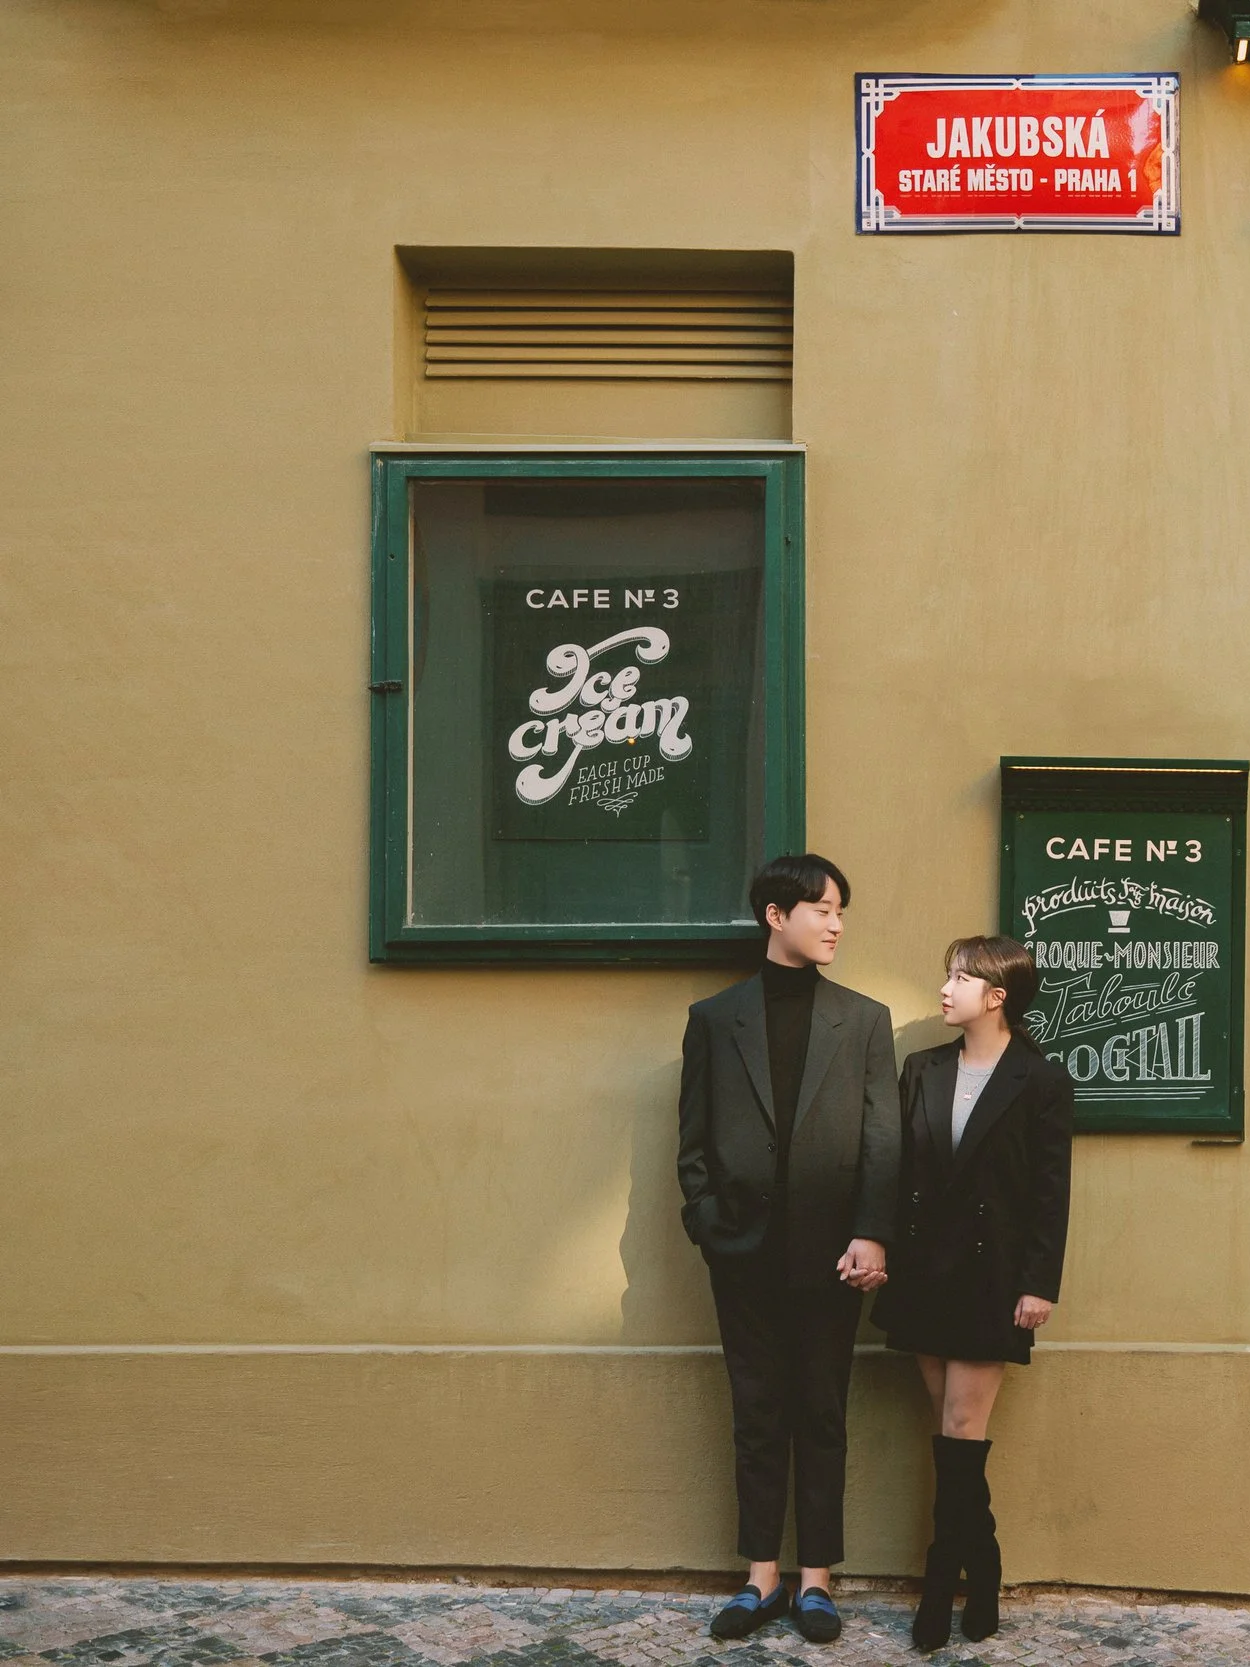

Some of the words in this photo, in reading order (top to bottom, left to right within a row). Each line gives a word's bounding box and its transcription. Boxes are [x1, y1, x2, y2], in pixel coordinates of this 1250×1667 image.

[926, 109, 1110, 159] JAKUBSKÁ
[899, 164, 961, 192] STARÉ
[967, 164, 1034, 192] MĚSTO
[1054, 168, 1122, 192] PRAHA
[1128, 168, 1137, 192] 1
[526, 589, 610, 609] CAFE
[663, 588, 679, 609] 3
[529, 626, 670, 716] Ice
[508, 696, 693, 805] cream
[577, 761, 618, 784] EACH
[624, 755, 651, 772] CUP
[568, 776, 622, 806] FRESH
[626, 766, 665, 790] MADE
[1046, 837, 1132, 861] CAFE
[1185, 840, 1202, 863] 3
[1022, 876, 1116, 937] produits
[1150, 881, 1216, 925] maison
[1039, 971, 1204, 1043] Taboulé
